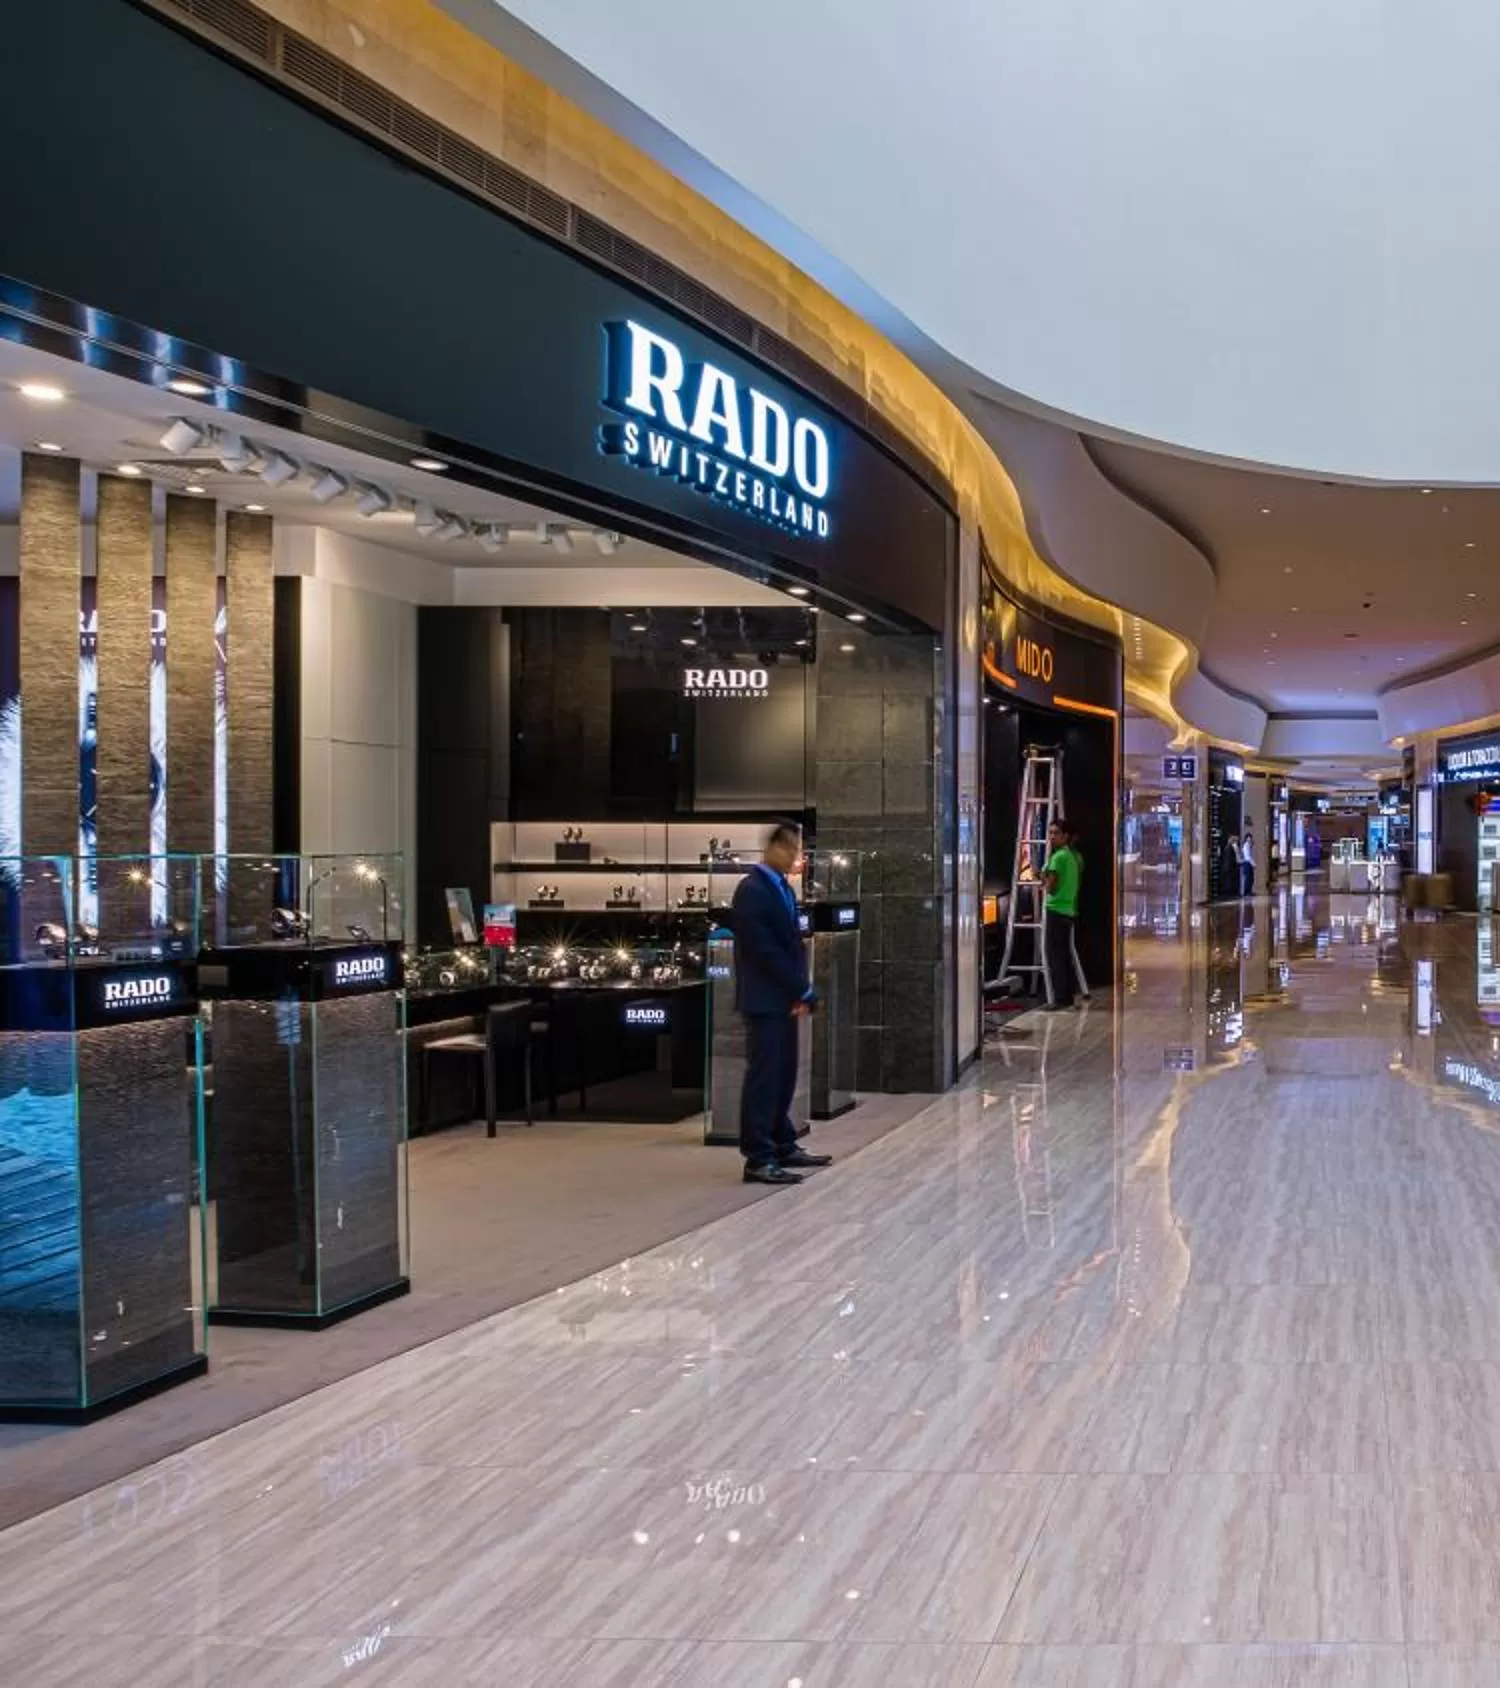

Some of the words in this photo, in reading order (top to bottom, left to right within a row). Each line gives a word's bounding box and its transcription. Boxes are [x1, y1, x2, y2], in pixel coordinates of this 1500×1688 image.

[625, 319, 829, 499] RADO
[624, 422, 829, 538] SWITZERLAND
[1016, 635, 1053, 683] MIDO
[684, 669, 769, 688] RADO
[336, 957, 385, 977] RADO
[104, 977, 170, 1001] RADO
[626, 1009, 665, 1018] RADO
